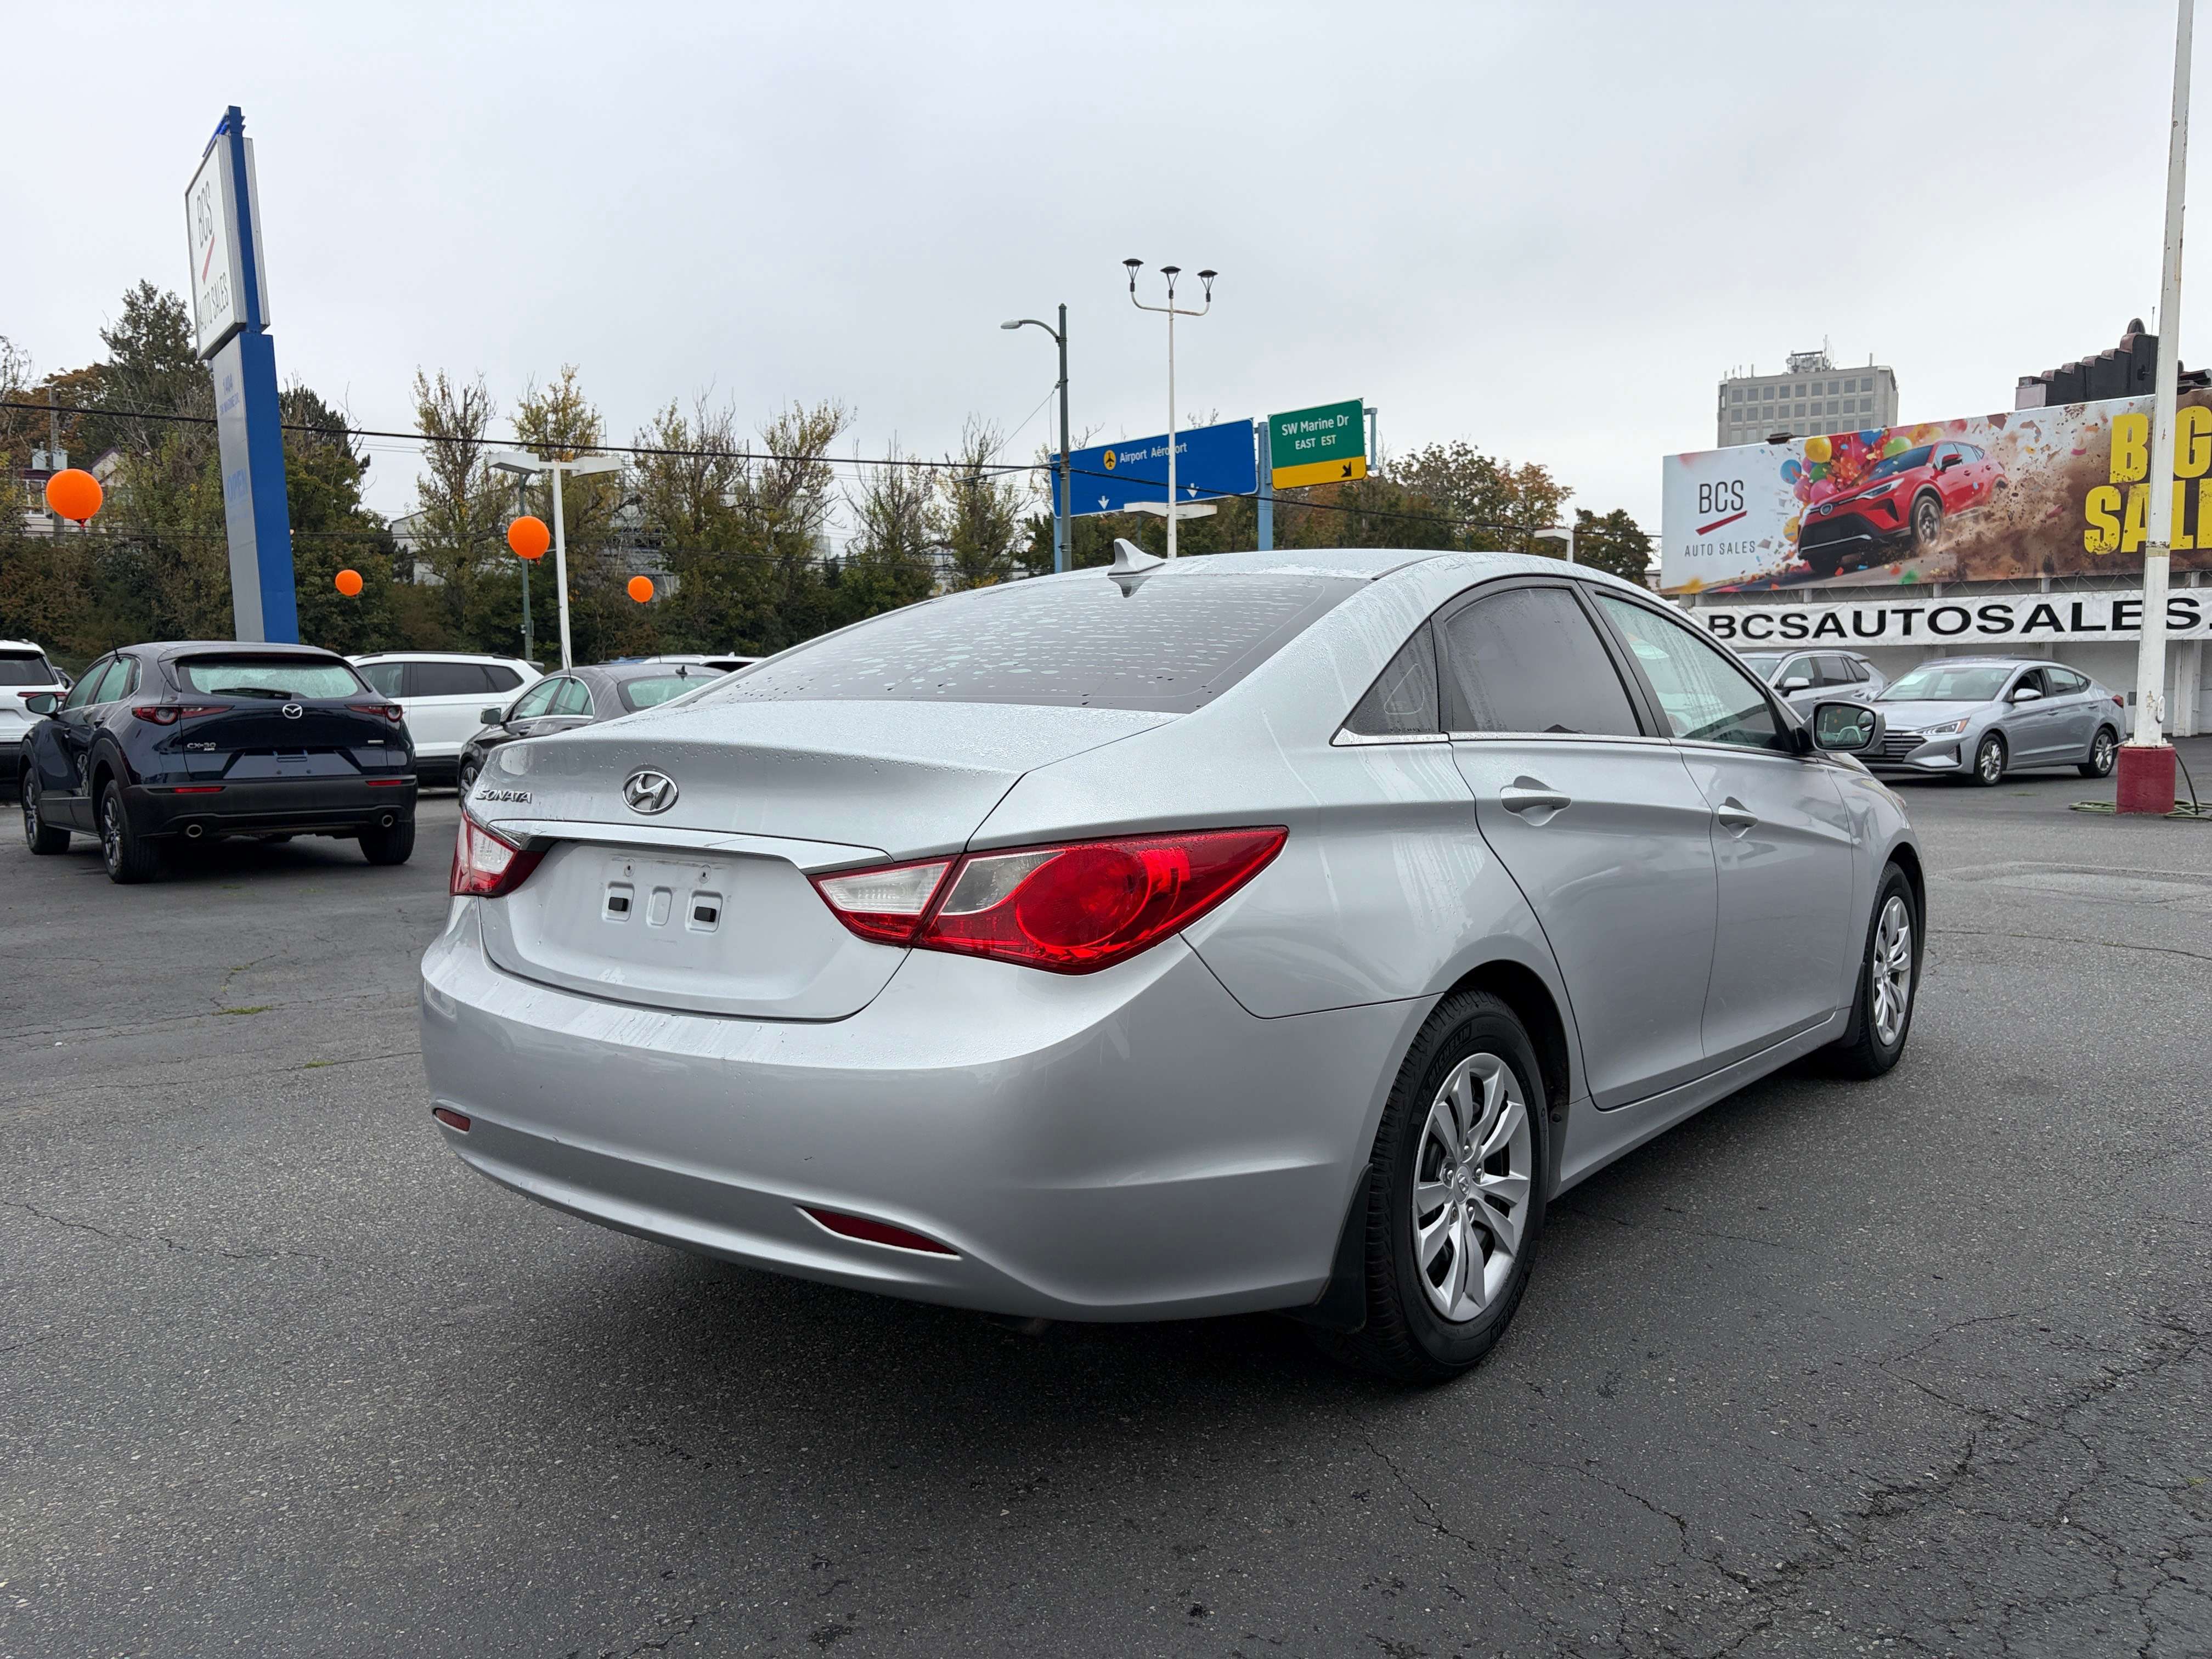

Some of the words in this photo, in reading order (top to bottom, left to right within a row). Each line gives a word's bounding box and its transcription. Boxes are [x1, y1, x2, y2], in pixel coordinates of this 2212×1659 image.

[197, 180, 213, 249] BCS
[211, 272, 229, 319] SALES
[1282, 422, 1298, 436] SW
[1300, 418, 1334, 433] Marine
[1336, 414, 1349, 427] Dr
[1120, 449, 1148, 464] Airport
[1151, 443, 1187, 458] Aéroort
[1295, 438, 1316, 450] EAST
[1321, 435, 1336, 446] EST
[2109, 406, 2212, 483] BG
[1699, 479, 1744, 514] BCS
[1684, 544, 1713, 557] AUTO
[1719, 540, 1756, 555] SALES
[475, 789, 532, 804] SONATA
[1428, 1026, 1470, 1088] MICHELIN
